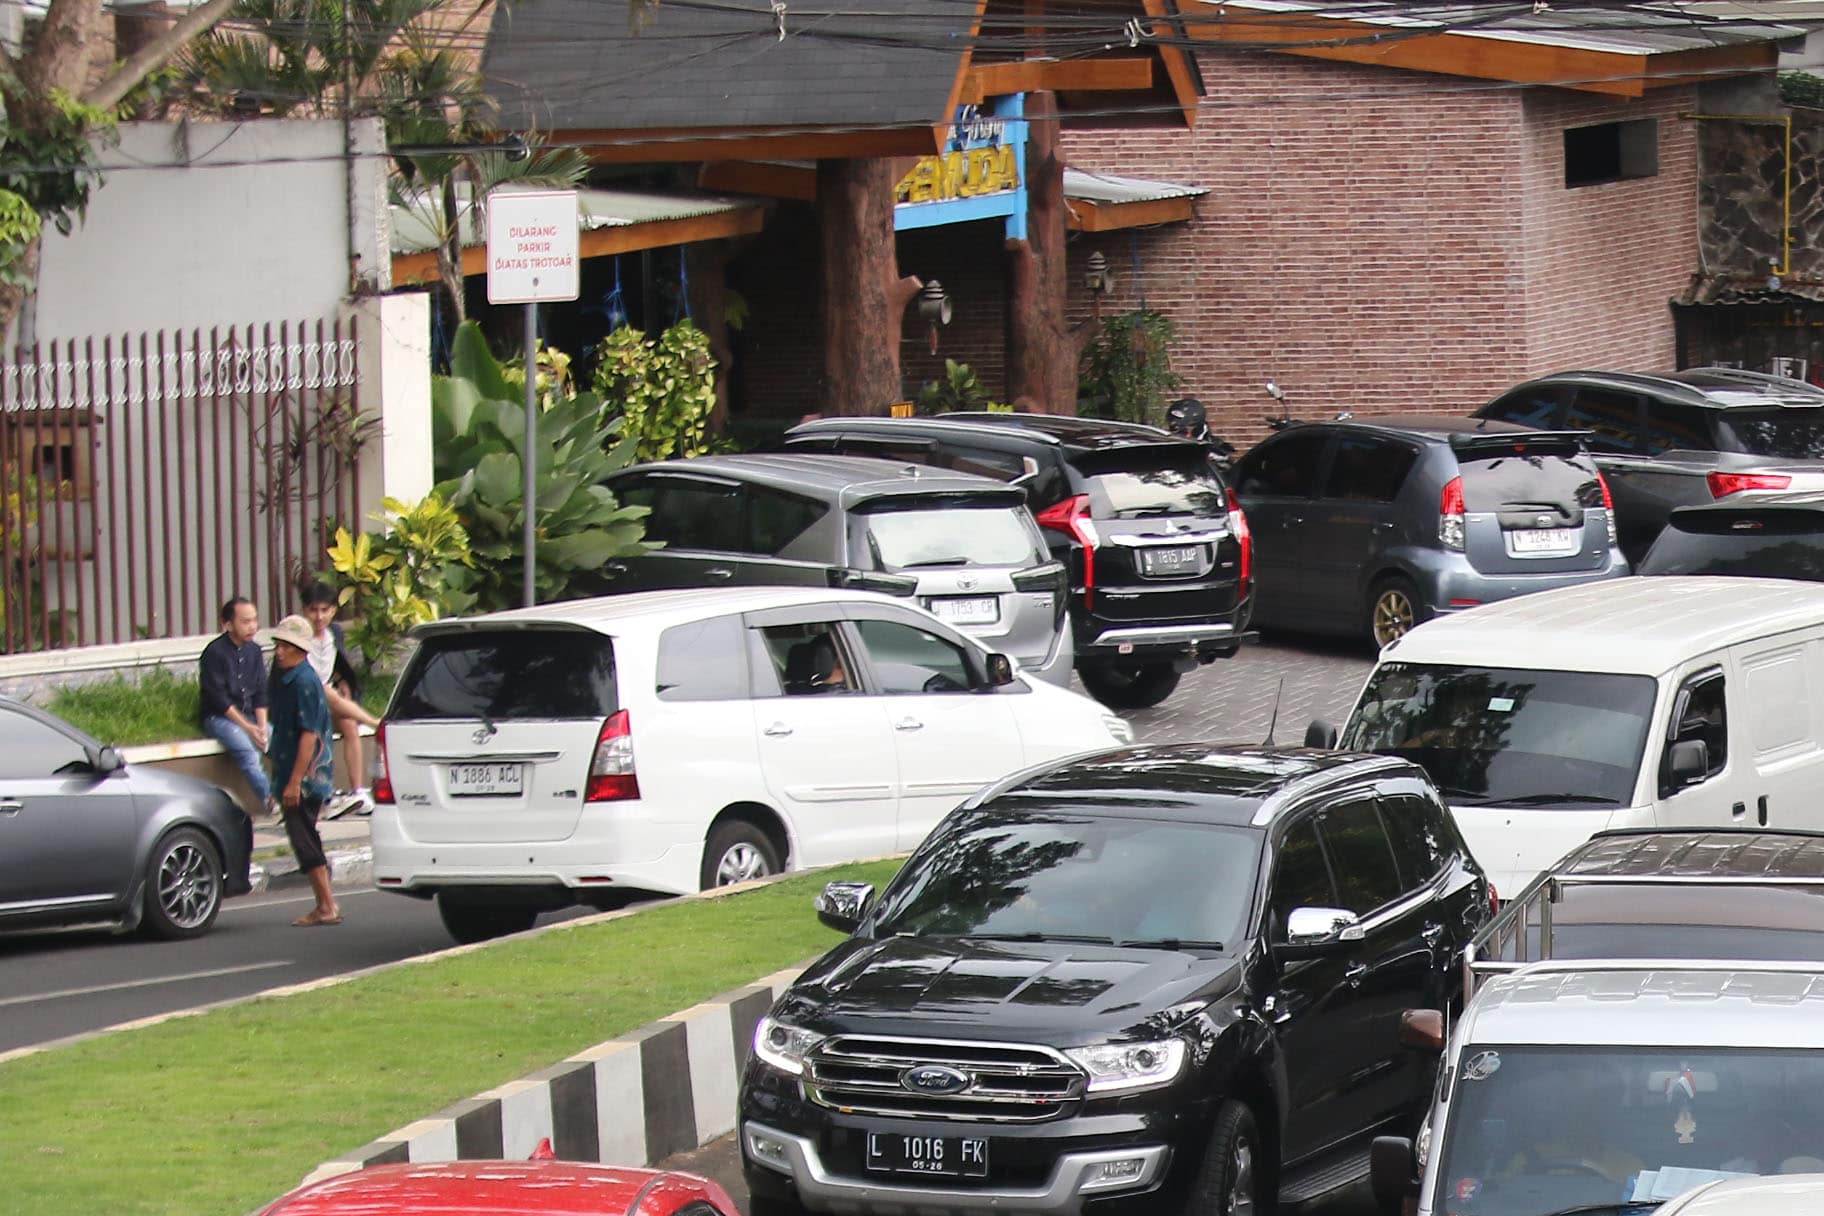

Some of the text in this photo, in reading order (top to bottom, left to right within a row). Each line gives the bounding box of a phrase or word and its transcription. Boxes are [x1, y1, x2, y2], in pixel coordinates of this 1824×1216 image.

[510, 226, 557, 238] DILARANG
[517, 243, 551, 253] PARKIR
[530, 257, 572, 268] TROTOAR
[450, 768, 458, 783] N
[872, 1135, 983, 1163] L 1016 FK
